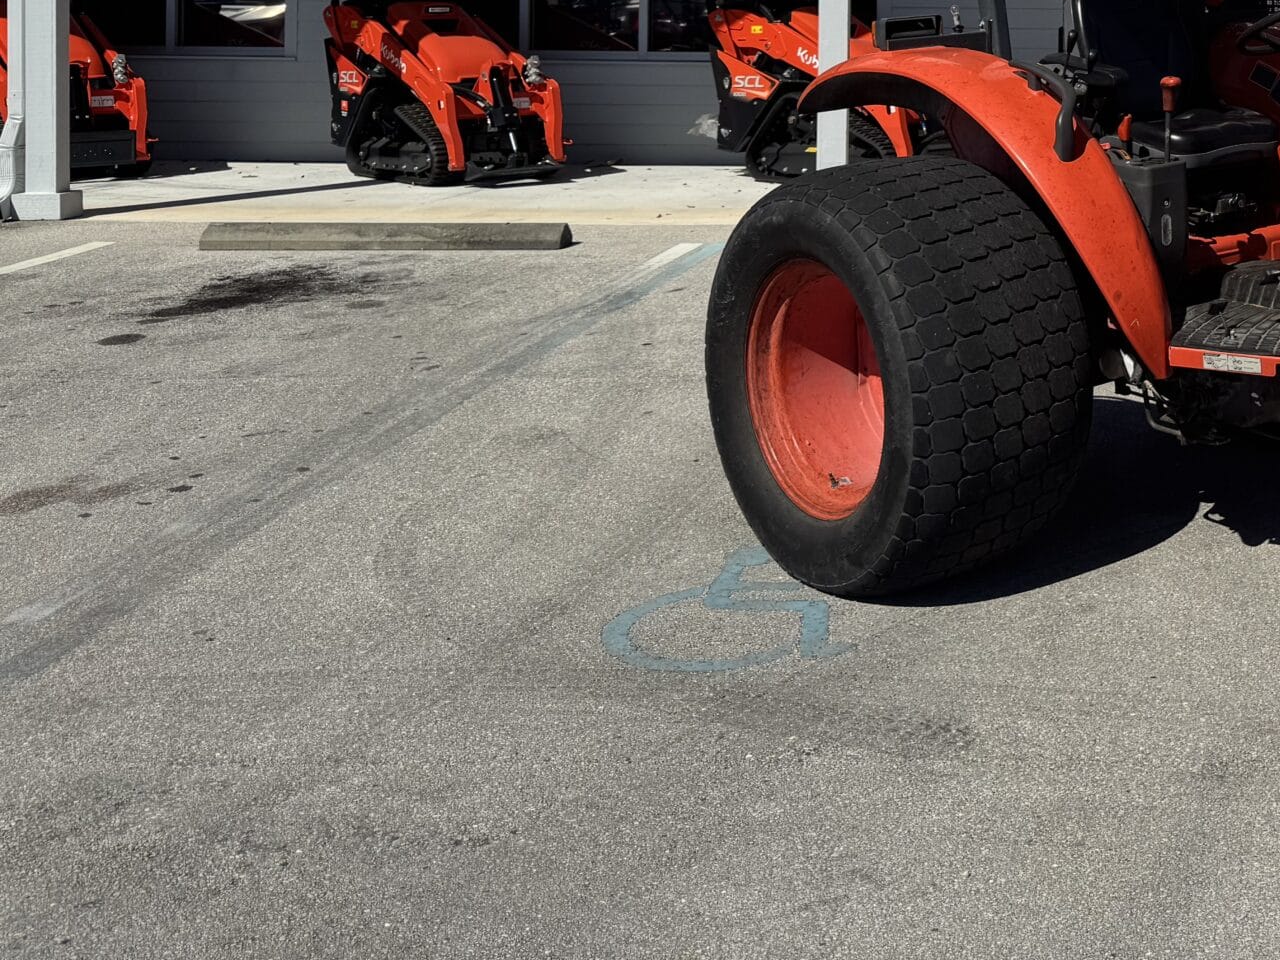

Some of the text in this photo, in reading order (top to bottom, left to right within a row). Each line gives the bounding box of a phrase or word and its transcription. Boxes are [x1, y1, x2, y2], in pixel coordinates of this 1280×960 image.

[381, 41, 407, 74] Kubota
[339, 71, 359, 83] SCL
[732, 75, 764, 88] SCL
